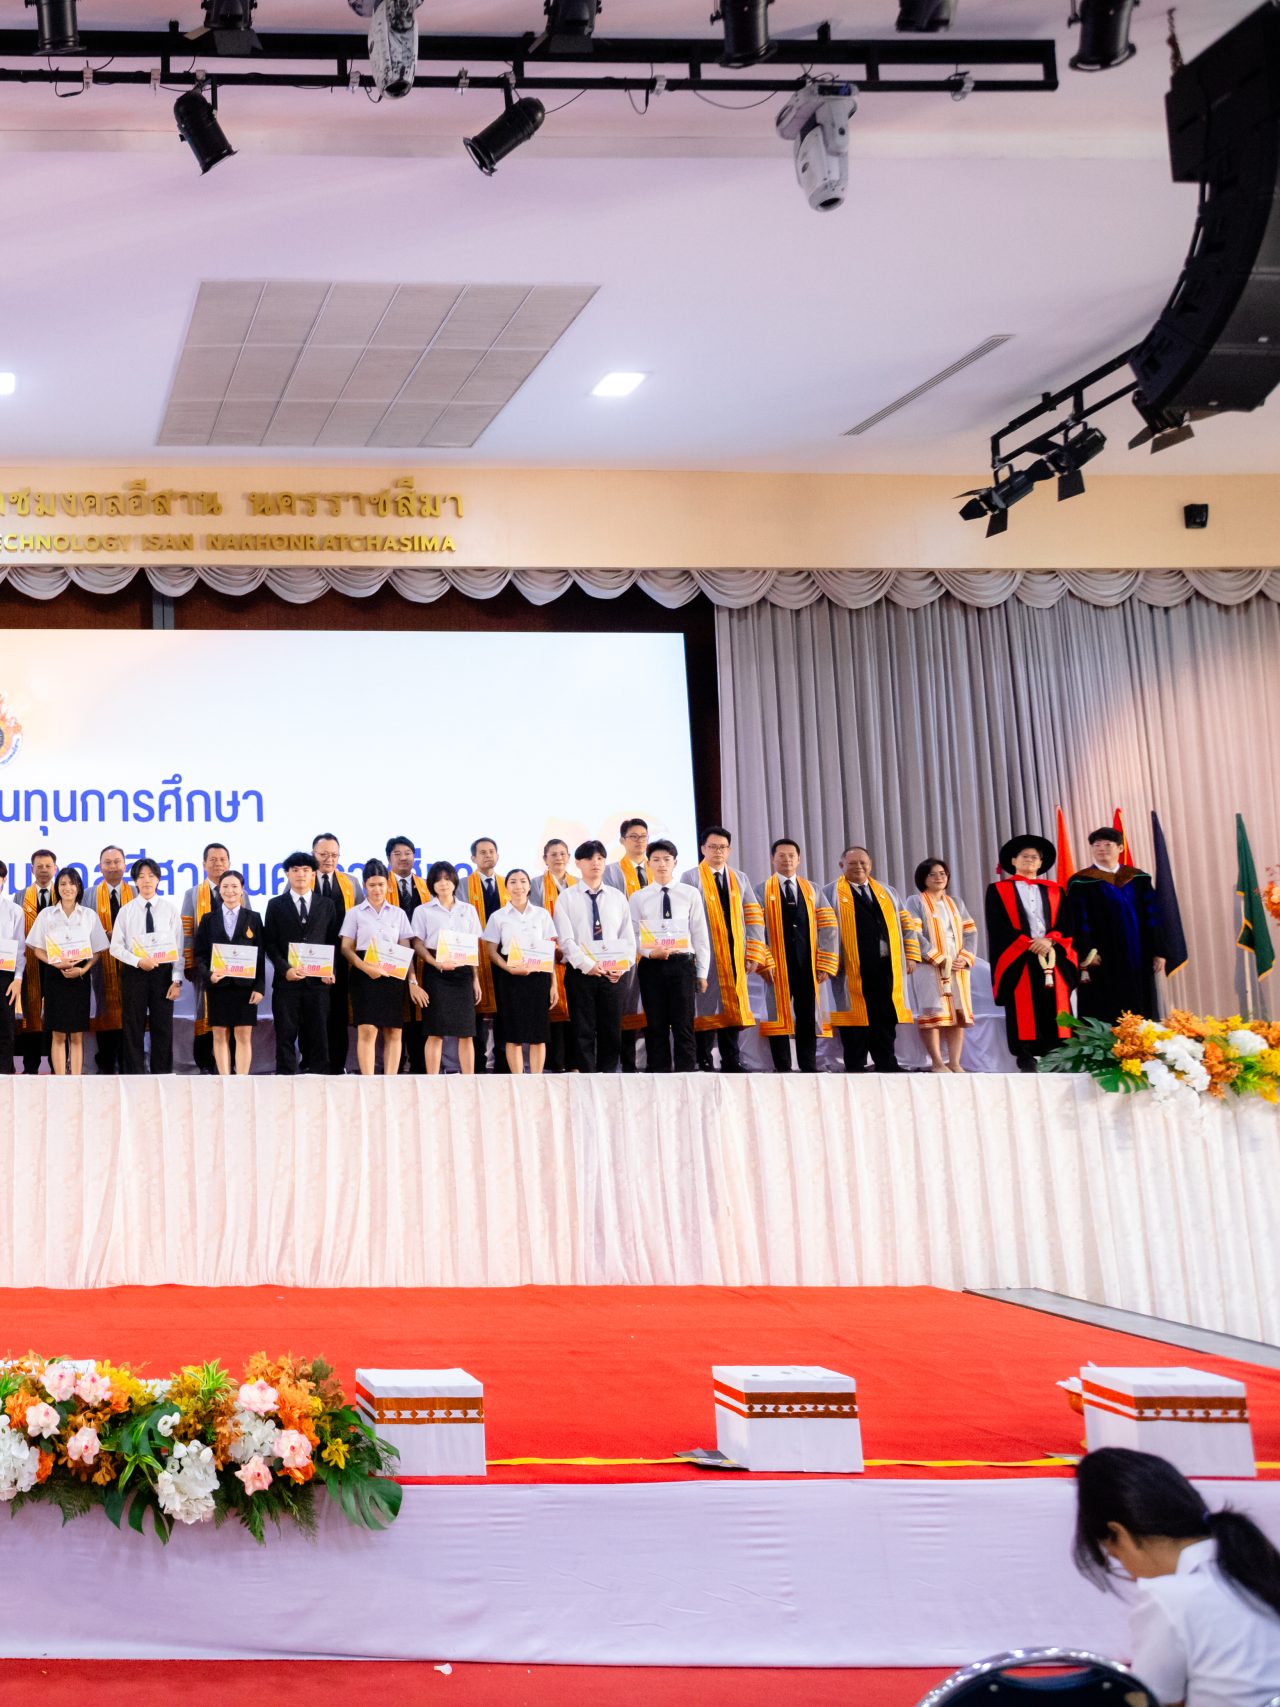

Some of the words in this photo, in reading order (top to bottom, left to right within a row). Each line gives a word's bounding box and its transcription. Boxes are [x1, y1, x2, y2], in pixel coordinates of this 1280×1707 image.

[248, 475, 465, 518] นครราชสีมา
[141, 534, 194, 552] ISAN
